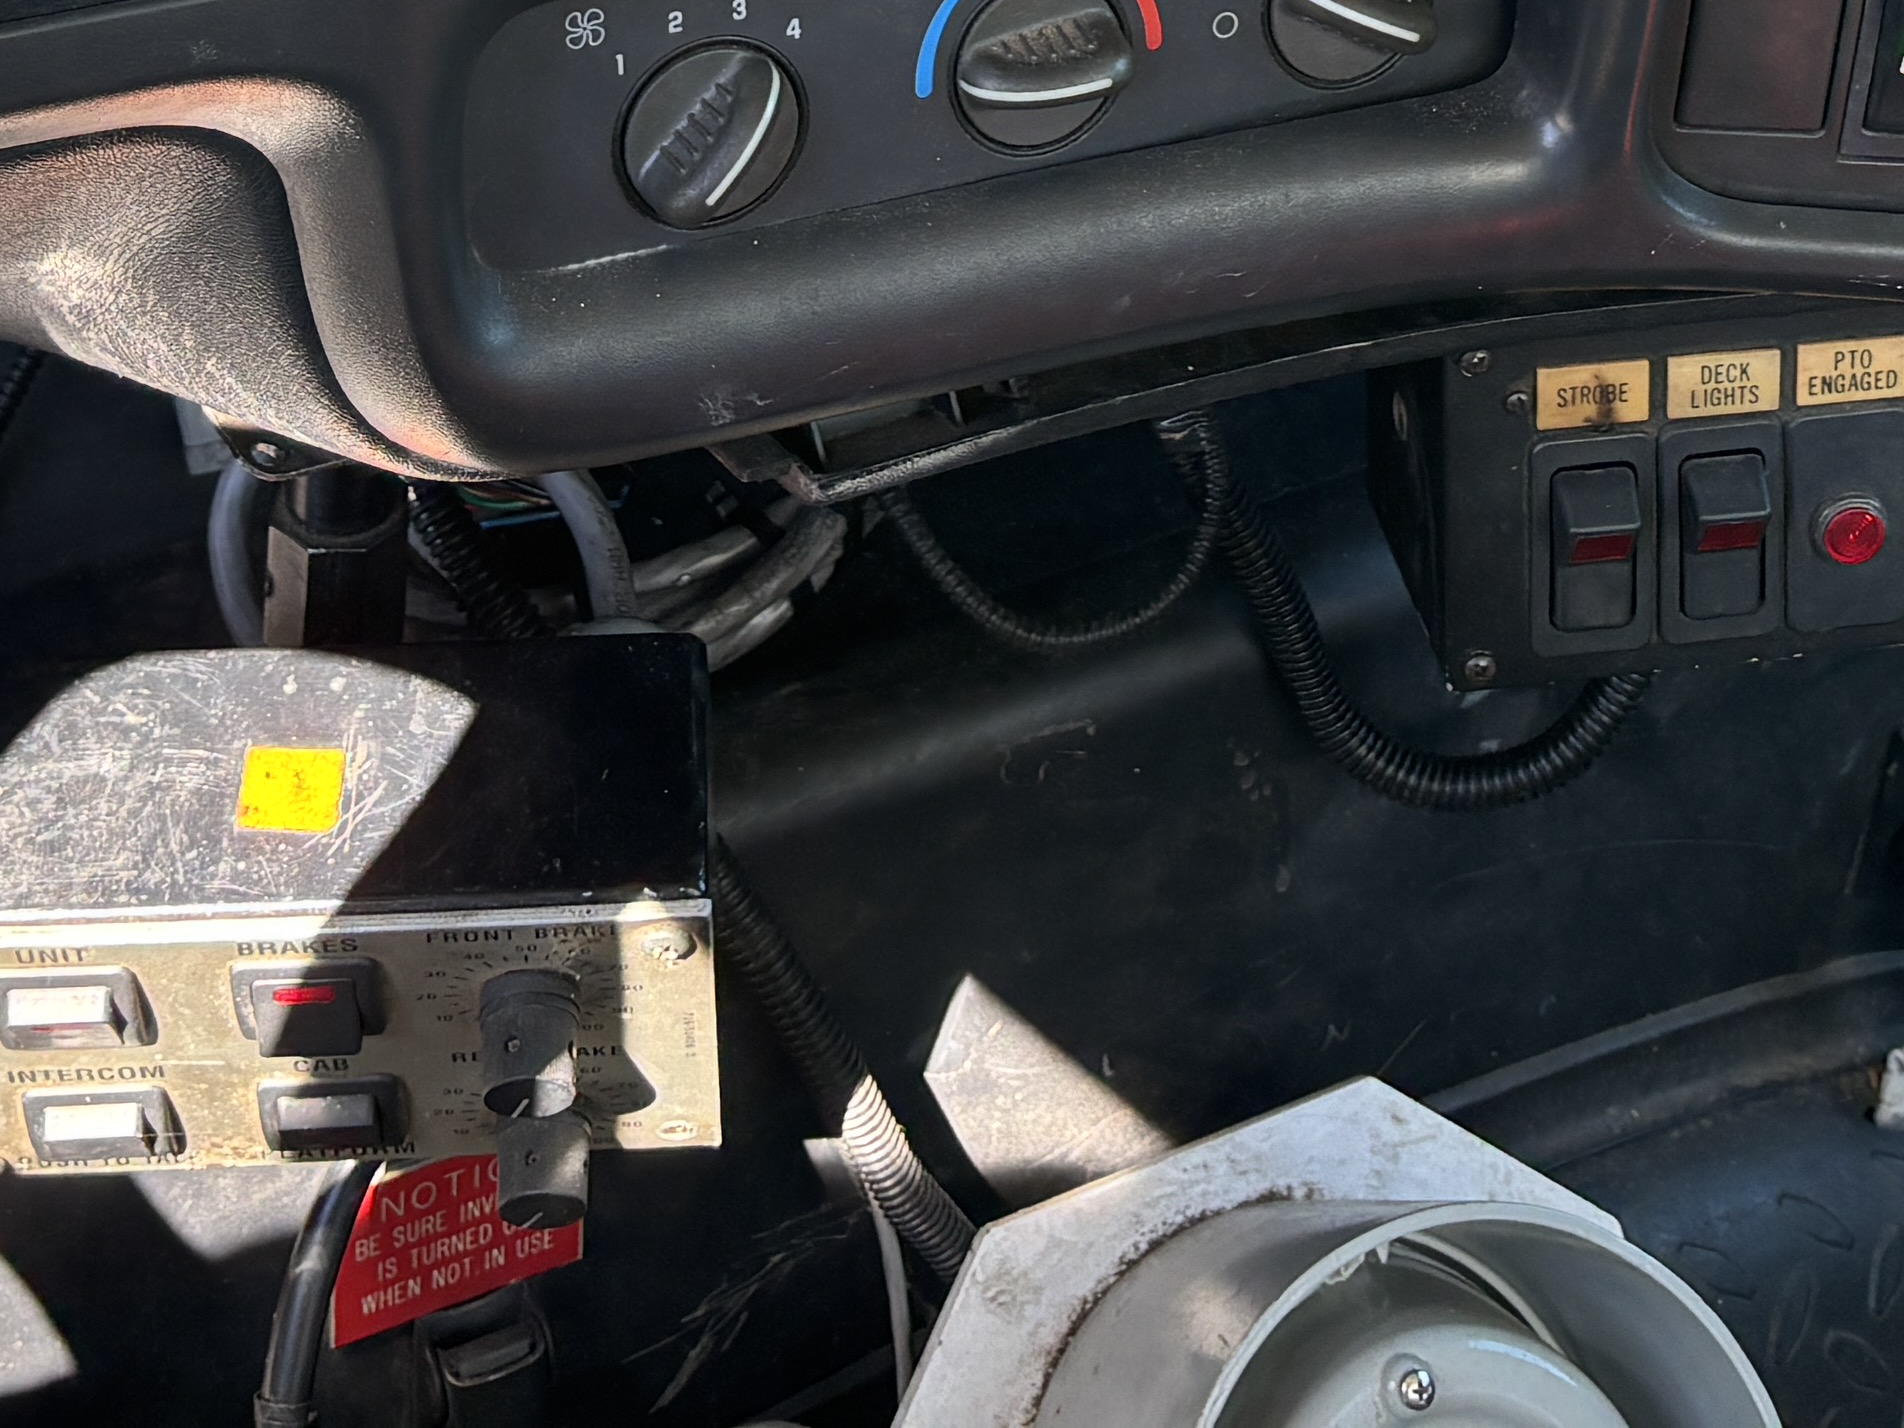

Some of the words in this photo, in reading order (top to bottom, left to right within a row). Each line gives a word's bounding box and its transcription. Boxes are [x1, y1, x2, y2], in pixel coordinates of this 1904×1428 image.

[667, 10, 684, 34] 2
[785, 17, 803, 40] 4
[615, 53, 625, 76] 1
[1834, 348, 1872, 371] PTO
[1700, 362, 1751, 386] DECK
[1808, 369, 1898, 396] ENGAGED
[1556, 382, 1630, 408] STROBE
[1690, 384, 1760, 409] LIGHTS
[237, 938, 359, 956] BRAKES
[426, 928, 514, 944] FRONT
[14, 947, 89, 964] UNIT
[7, 1064, 166, 1084] INTERCOM
[293, 1057, 350, 1073] CAB
[380, 1163, 499, 1224] NOTI
[355, 1233, 382, 1263] BE
[392, 1208, 447, 1248] SURE
[377, 1256, 398, 1282] IS
[410, 1222, 493, 1270] TURNED
[361, 1275, 423, 1317] WHEN
[431, 1256, 473, 1290] NOT
[484, 1246, 506, 1270] IN
[516, 1230, 554, 1259] USE
